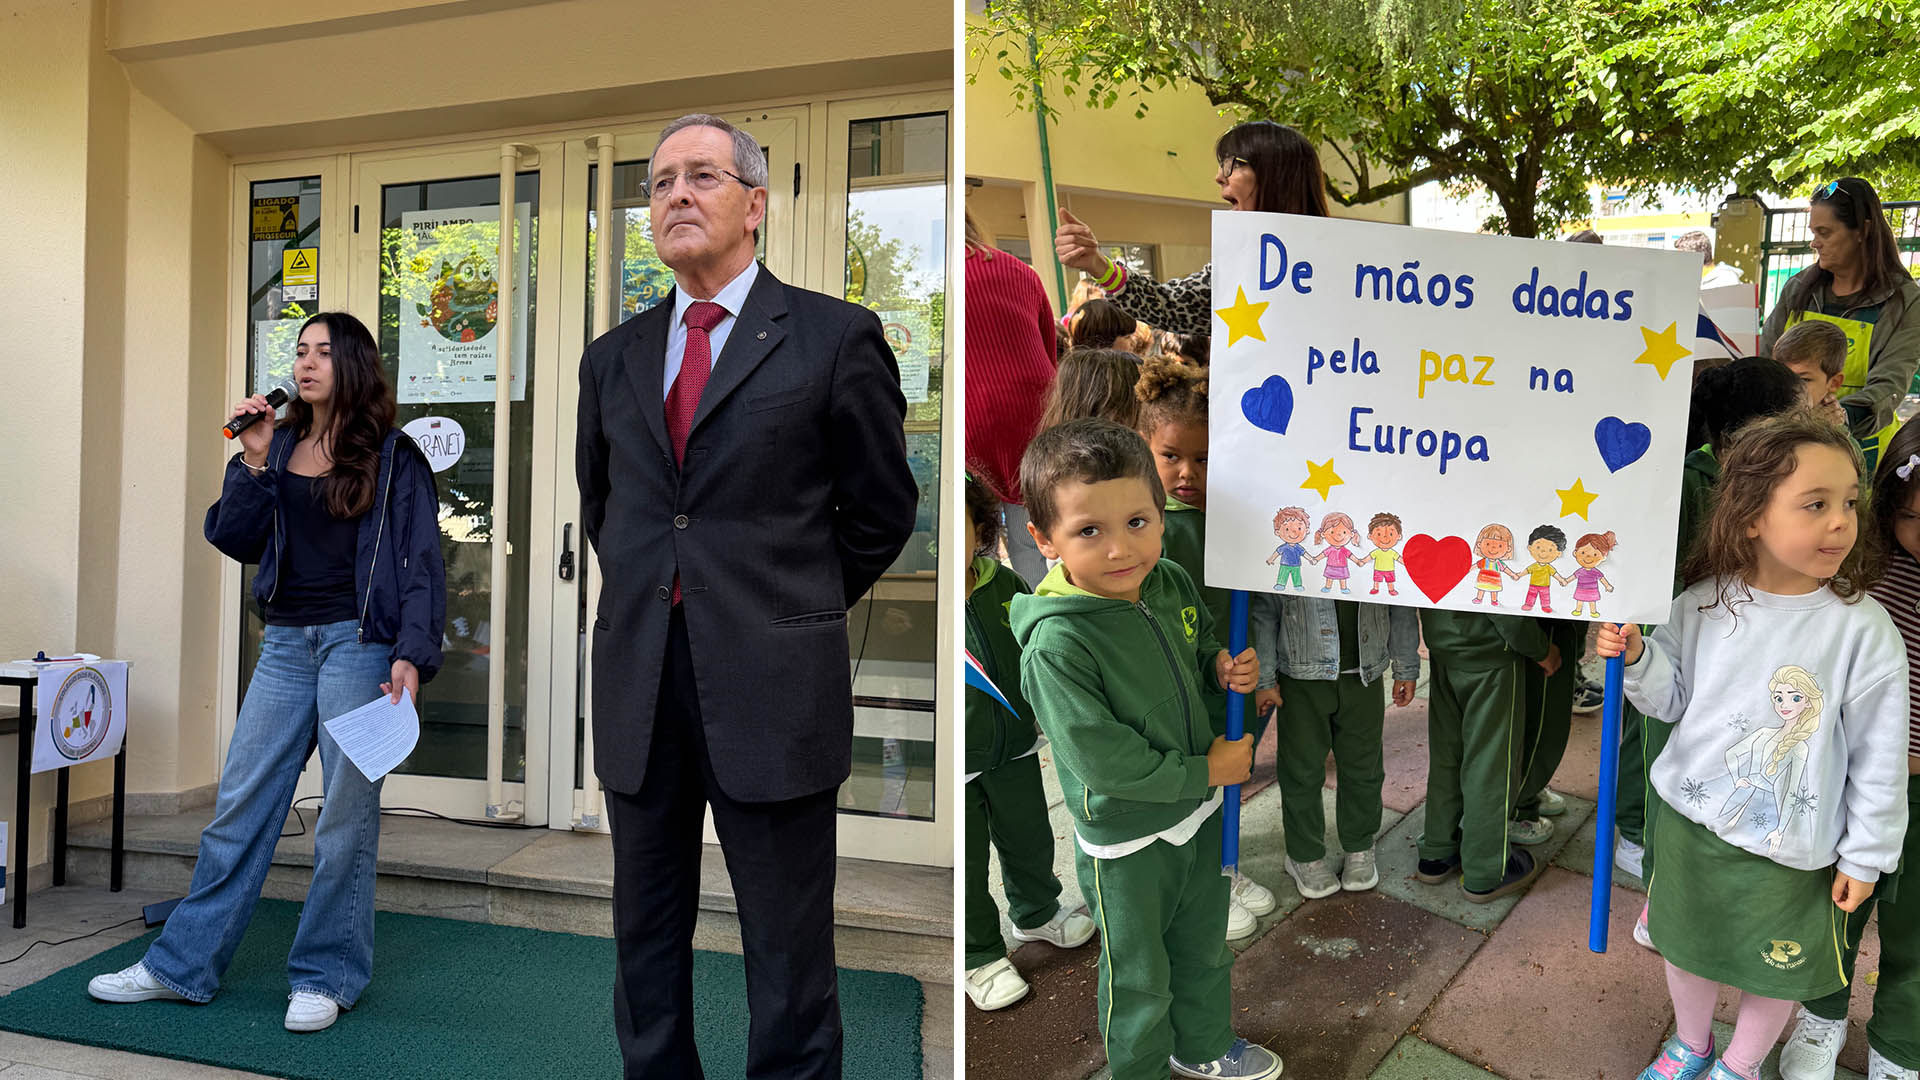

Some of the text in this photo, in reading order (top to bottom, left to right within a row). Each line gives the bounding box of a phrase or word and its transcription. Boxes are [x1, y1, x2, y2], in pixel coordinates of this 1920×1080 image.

[258, 197, 296, 206] LIGADO
[254, 231, 297, 240] PROSEGUR
[1259, 233, 1633, 321] De mãos dadas
[1306, 338, 1574, 399] pela paz na
[1349, 407, 1489, 474] Europa
